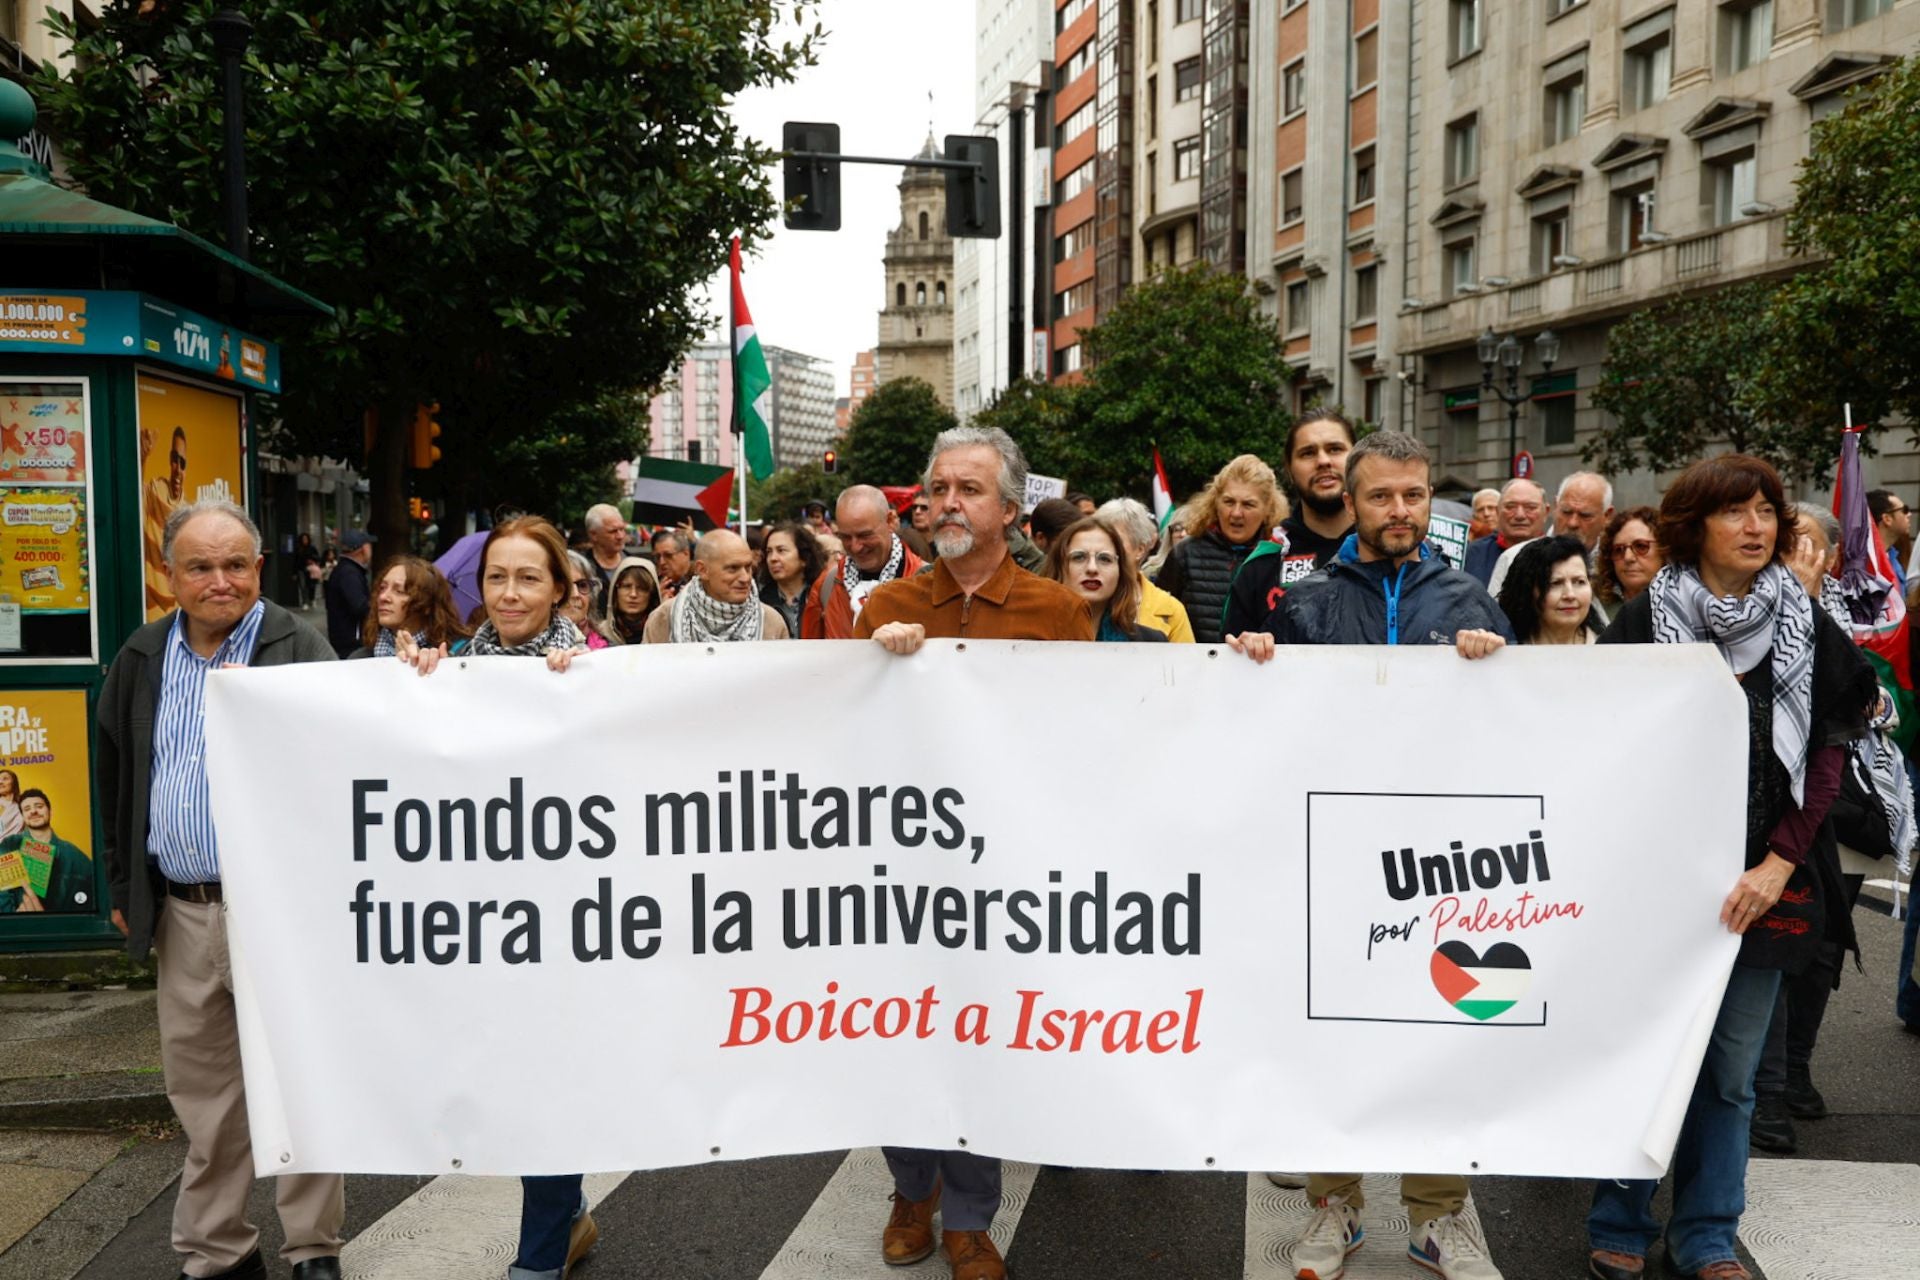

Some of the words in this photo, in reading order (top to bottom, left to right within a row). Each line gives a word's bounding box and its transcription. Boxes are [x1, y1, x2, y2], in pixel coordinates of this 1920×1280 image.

[17, 129, 54, 171] BVA
[173, 327, 210, 362] 11/11
[1281, 570, 1311, 585] ISR
[1282, 558, 1315, 574] FCK
[9, 754, 54, 767] JUGADO
[352, 777, 617, 862] Fondos
[645, 769, 985, 864] militares,
[1381, 829, 1551, 901] Uniovi
[349, 879, 542, 964] fuera
[571, 877, 662, 963] de
[692, 873, 753, 954] la
[782, 864, 1201, 956] universidad
[1367, 915, 1420, 961] por
[1428, 890, 1585, 945] Palestina
[719, 981, 941, 1049] Boicot
[954, 1001, 991, 1046] a
[1005, 987, 1205, 1055] Israel
